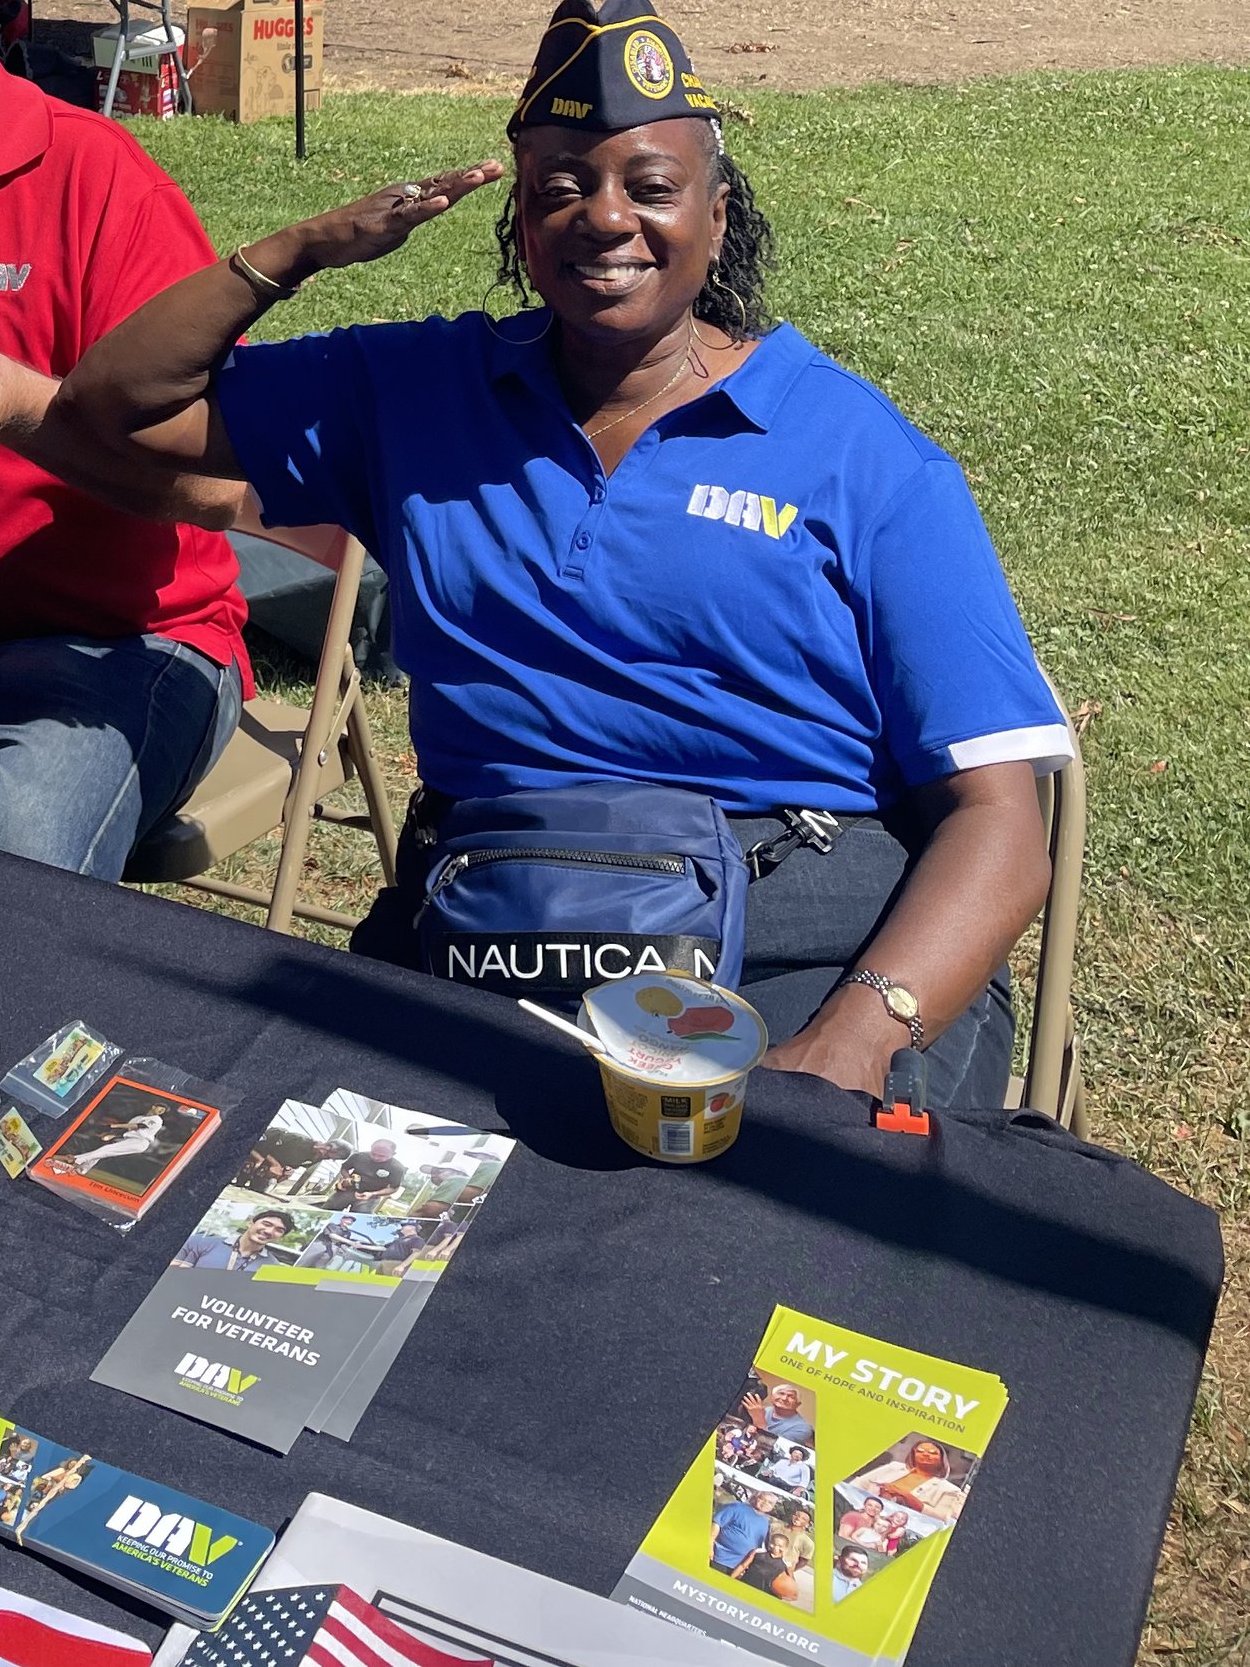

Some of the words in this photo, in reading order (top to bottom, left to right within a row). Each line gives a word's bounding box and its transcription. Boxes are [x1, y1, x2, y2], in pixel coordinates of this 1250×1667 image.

[253, 17, 314, 40] HUGGS
[551, 97, 593, 119] DAV
[687, 483, 799, 540] DAV
[448, 943, 667, 981] NAUTICA
[171, 1305, 213, 1332] FOR
[213, 1320, 321, 1368] VETERANS
[200, 1294, 316, 1347] VOLUNTEER
[173, 1352, 259, 1395] DAV
[779, 1354, 804, 1372] ONE
[806, 1365, 823, 1377] OF
[823, 1373, 856, 1392] HOPE
[857, 1387, 884, 1403] AND
[885, 1398, 966, 1434] INSPIRATION
[785, 1331, 849, 1369] MY
[849, 1359, 981, 1420] STORY
[105, 1494, 239, 1568] DAV
[111, 1541, 161, 1567] AMERICA'S
[160, 1560, 210, 1588] VETERANS
[116, 1534, 149, 1554] KEEPING
[150, 1547, 167, 1561] OUR
[167, 1555, 201, 1575] PROMISE
[201, 1569, 214, 1580] TO
[628, 1595, 659, 1616] NATIONAL
[658, 1609, 708, 1638] HEADQUARTERS
[672, 1579, 821, 1654] MYSTORY.DAV.ORG
